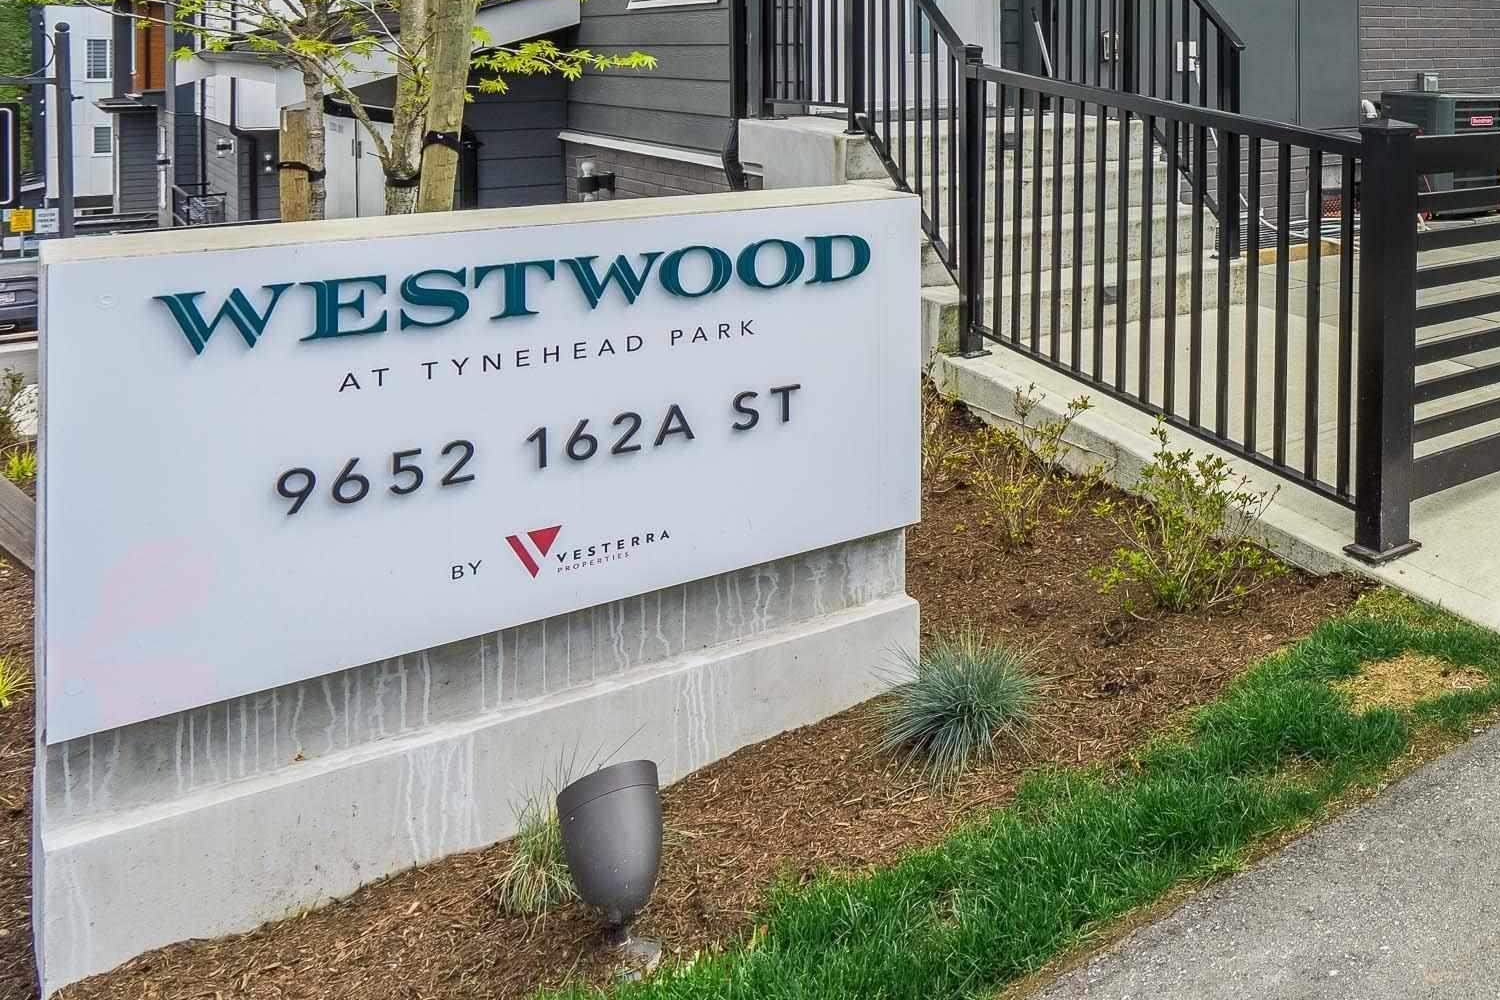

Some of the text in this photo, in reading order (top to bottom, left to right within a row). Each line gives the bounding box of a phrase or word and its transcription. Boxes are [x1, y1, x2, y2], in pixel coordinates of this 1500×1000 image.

[152, 234, 871, 356] WESTWOOD
[338, 319, 757, 393] AT TYNEHEAD PARK
[276, 383, 802, 516] 9652 162A ST
[451, 529, 671, 580] BY VESTERRA
[556, 551, 630, 574] PROPERTIES
